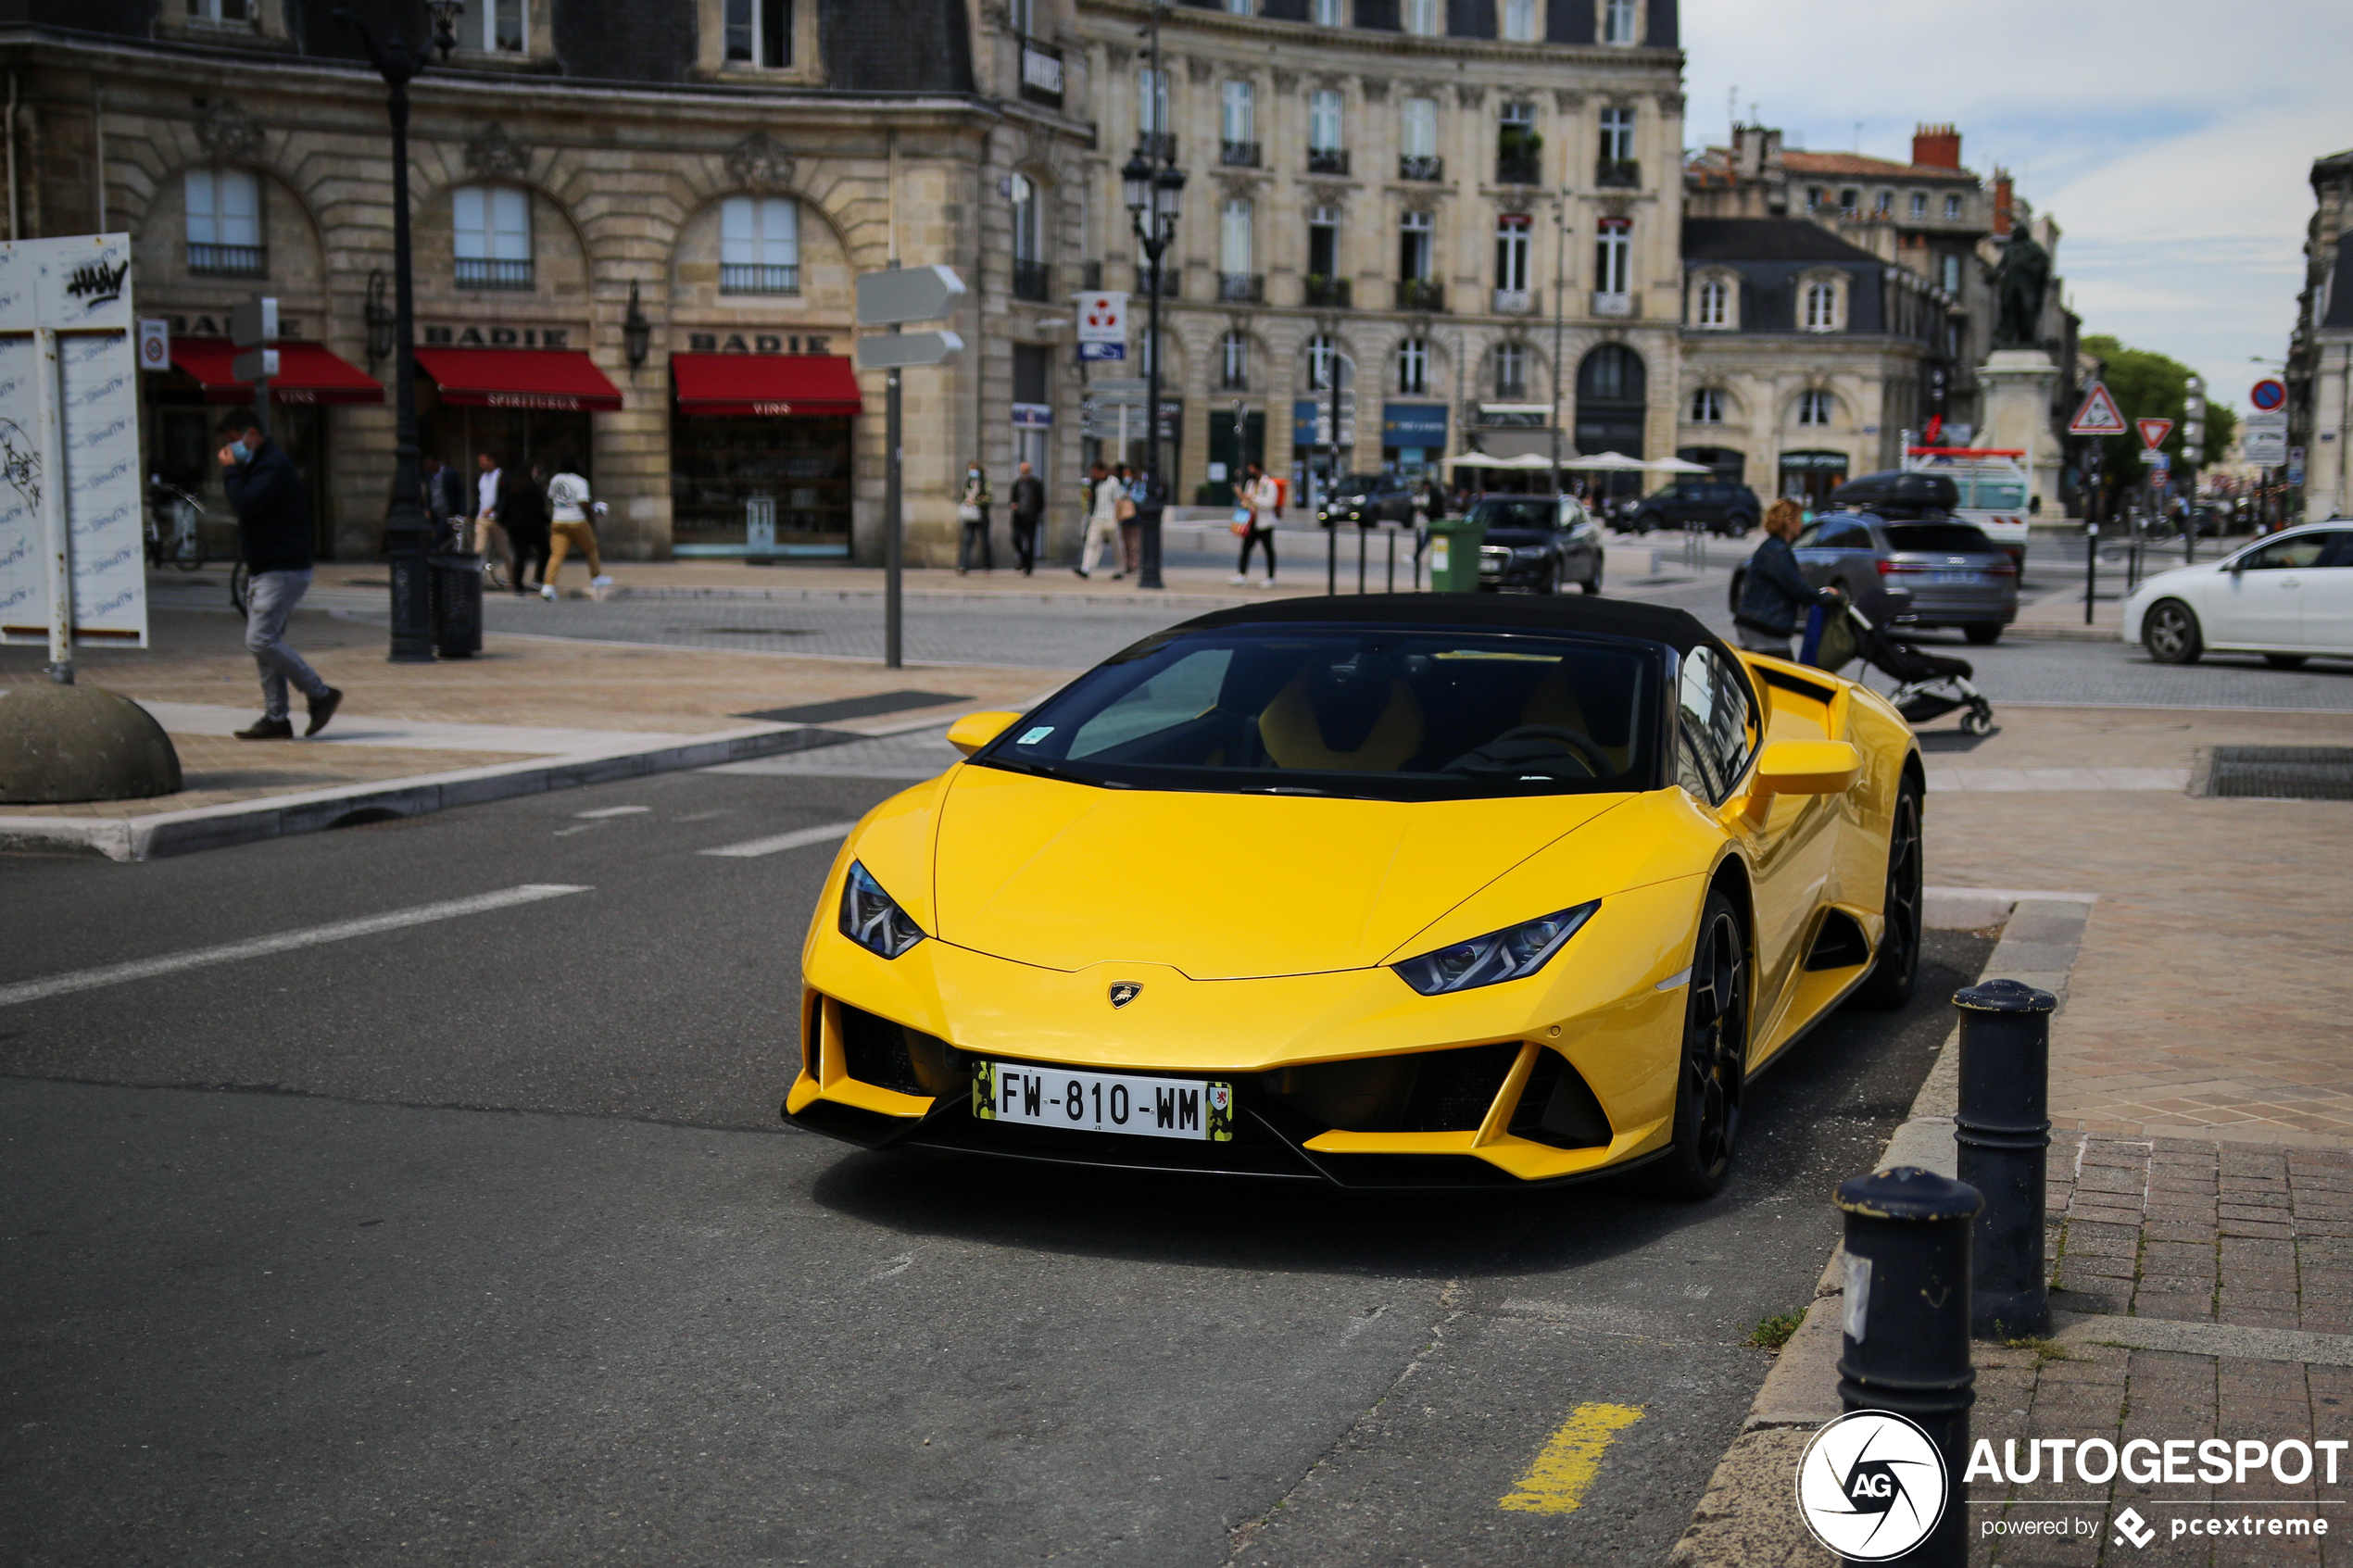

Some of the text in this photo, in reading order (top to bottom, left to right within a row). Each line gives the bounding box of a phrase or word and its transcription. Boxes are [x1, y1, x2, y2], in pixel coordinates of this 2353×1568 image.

[424, 326, 568, 346] BADIE
[689, 333, 830, 354] BADIE
[279, 390, 315, 403] VINS
[487, 394, 580, 410] SPIRITUEUX
[754, 402, 791, 415] VINS
[1002, 1073, 1198, 1131] FW-810-WM
